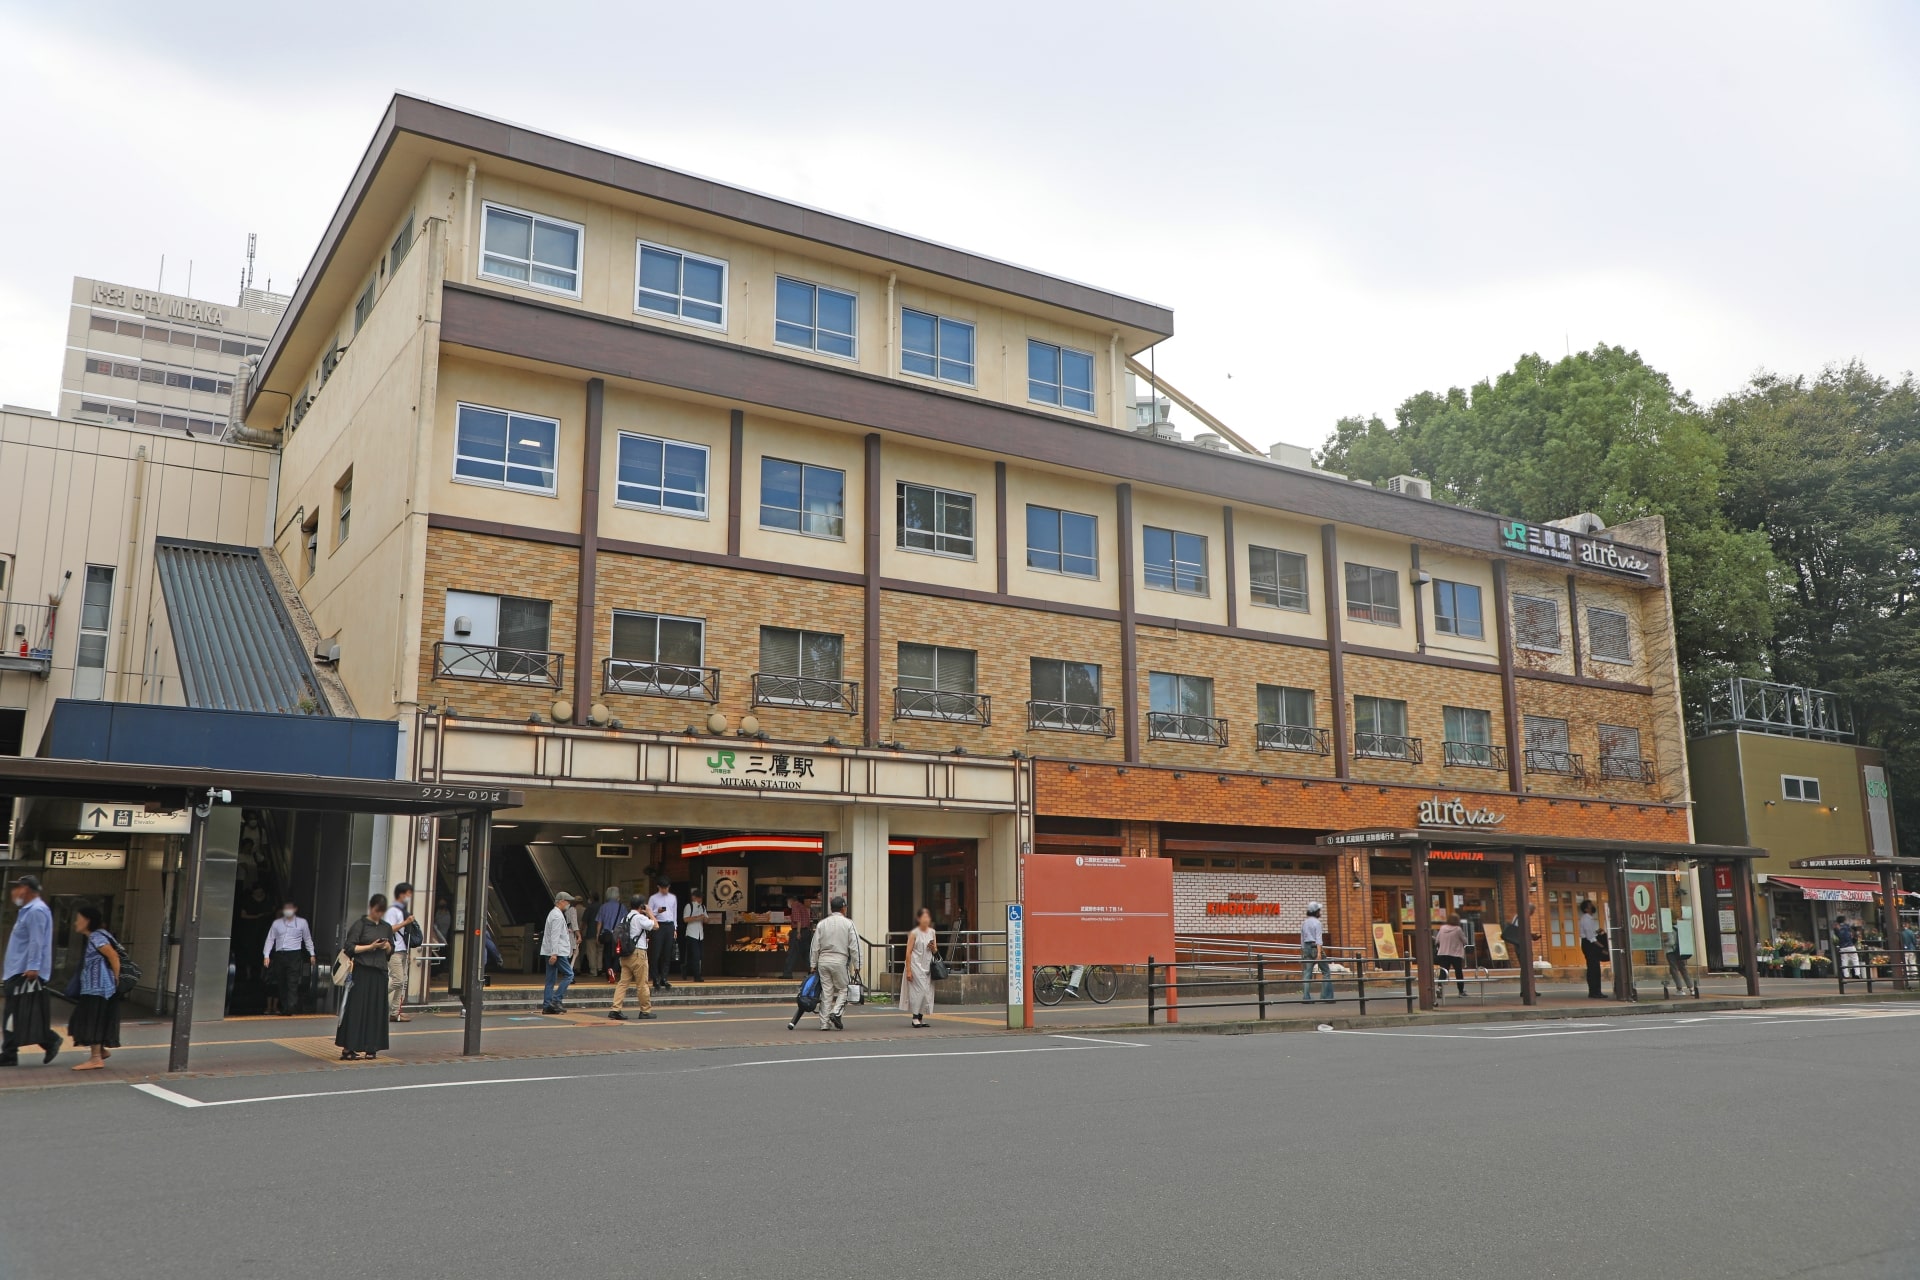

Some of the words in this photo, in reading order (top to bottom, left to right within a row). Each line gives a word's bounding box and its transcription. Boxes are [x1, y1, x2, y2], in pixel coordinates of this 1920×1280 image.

[92, 285, 127, 308] NEO
[131, 293, 164, 314] CITY
[168, 299, 223, 326] MITAKA
[1504, 522, 1527, 542] JR
[1529, 544, 1549, 556] Mitaka
[1551, 549, 1572, 561] Station
[707, 750, 735, 769] JR
[746, 754, 815, 778] 三鷹駅
[720, 777, 759, 788] MITAKA
[760, 779, 802, 790] STATION
[421, 787, 501, 802] タクシーのりば
[69, 851, 121, 861] エレベーター
[1718, 873, 1726, 886] 1
[1206, 902, 1281, 916] KINOKUNIYA
[1630, 913, 1658, 930] のりば
